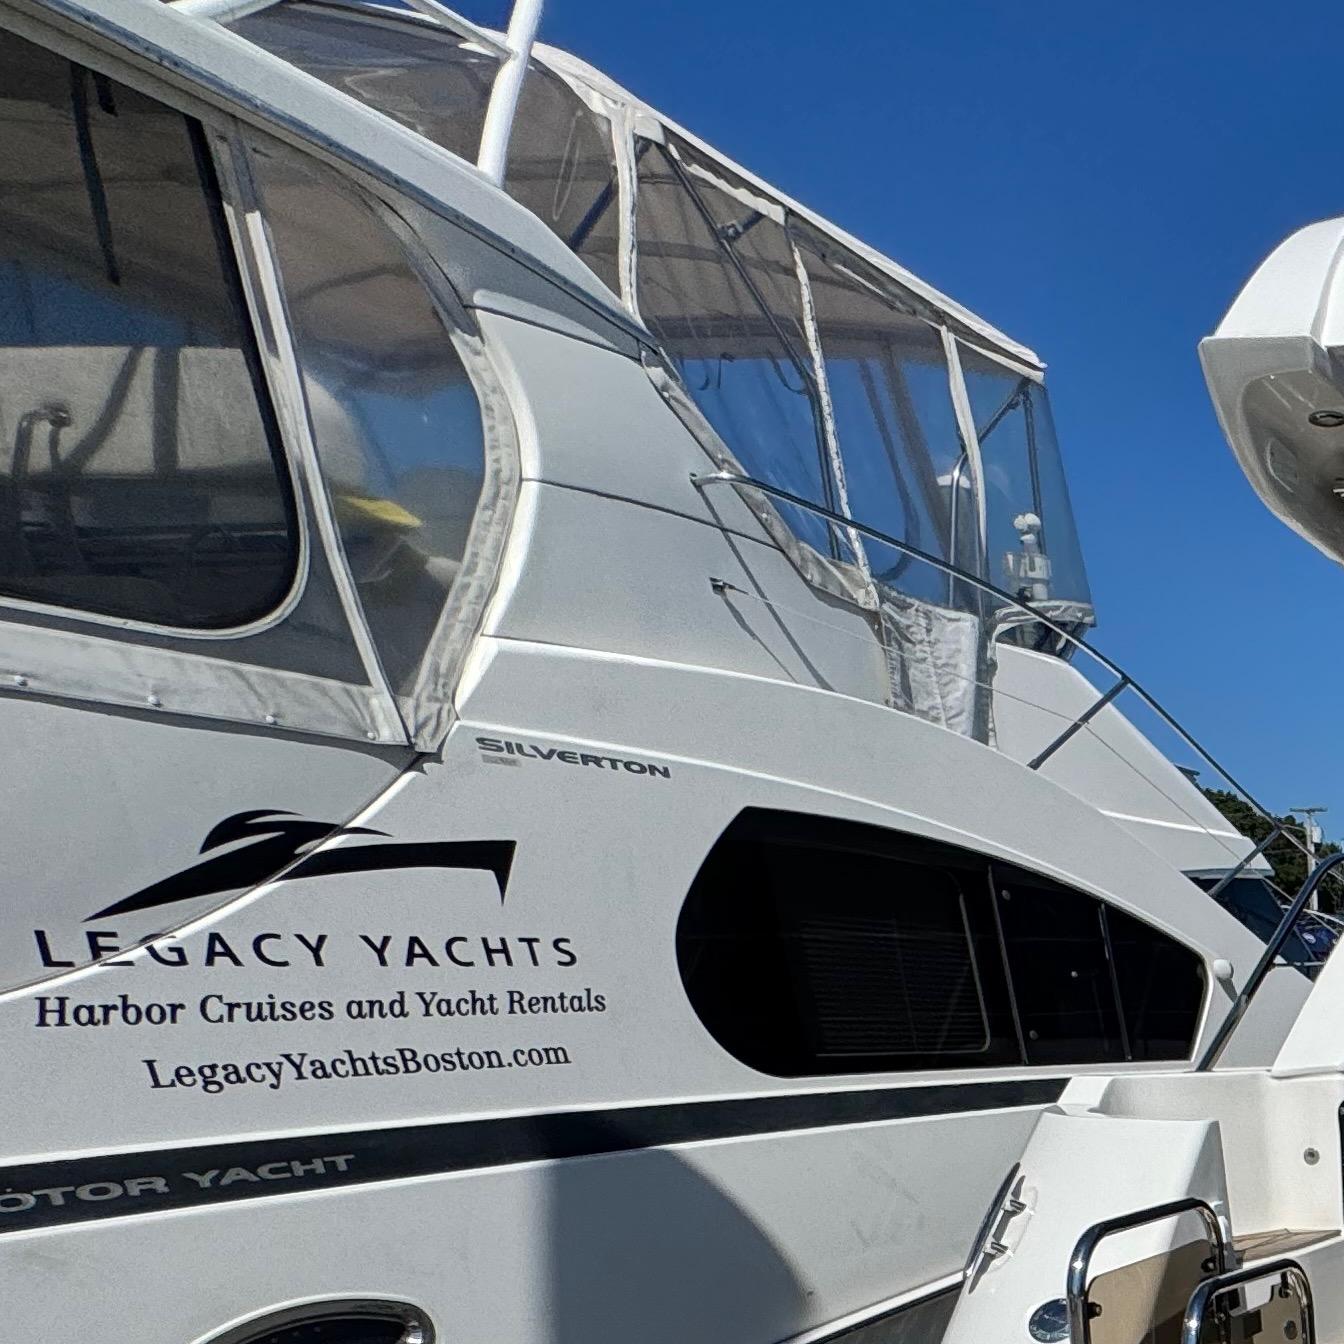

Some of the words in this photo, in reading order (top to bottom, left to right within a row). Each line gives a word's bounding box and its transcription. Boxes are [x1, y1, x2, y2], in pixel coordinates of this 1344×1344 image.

[475, 737, 671, 779] SILVERTON
[34, 930, 327, 968] LEGACY
[358, 934, 578, 967] YACHTS
[35, 994, 186, 1028] Harbor
[200, 994, 334, 1023] Cruises
[346, 991, 409, 1019] and
[415, 989, 499, 1017] Yacht
[506, 988, 607, 1014] Rentals
[142, 1046, 572, 1094] LegacyYachtsBoston.com
[181, 1154, 356, 1189] YACHT
